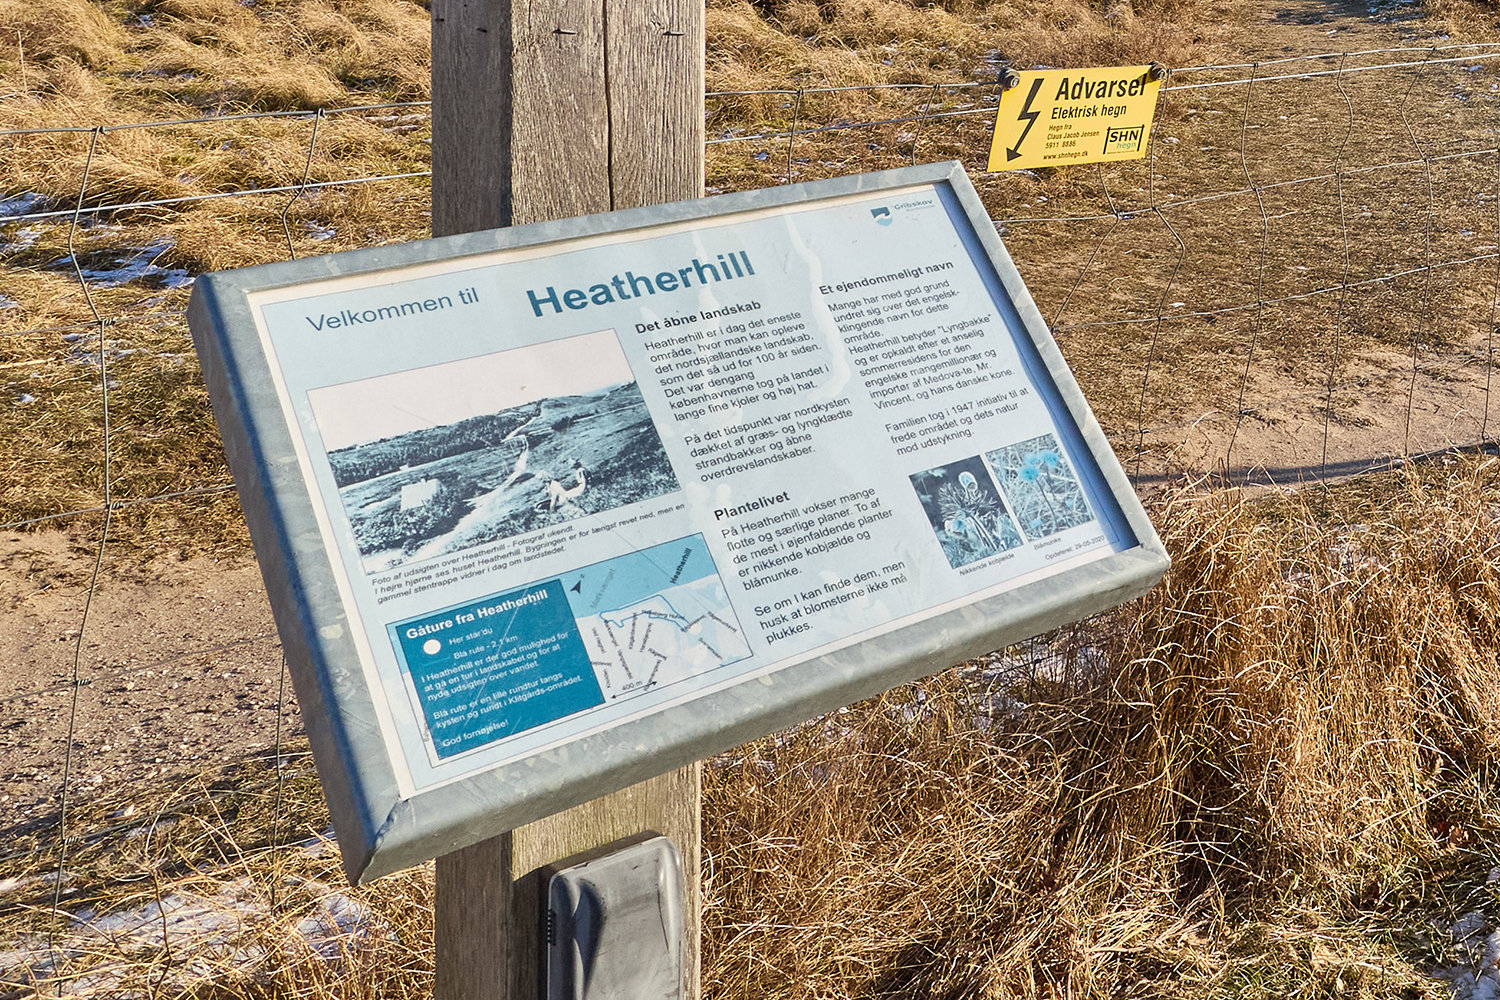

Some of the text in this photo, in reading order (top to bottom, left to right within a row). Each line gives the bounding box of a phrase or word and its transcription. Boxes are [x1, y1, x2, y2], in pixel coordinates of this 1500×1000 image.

[1055, 74, 1148, 101] Advarsel
[1048, 124, 1063, 132] Hegn
[1051, 104, 1127, 120] Elektrisk hegn
[1063, 131, 1080, 139] Jacob
[1080, 130, 1100, 138] Jensen
[1109, 130, 1139, 143] SHN
[526, 250, 755, 317] Heatherhill
[819, 262, 954, 295] Et ejendommeligt navn
[827, 280, 950, 312] Mange har med god grund
[306, 287, 479, 331] Velkommen til
[635, 300, 761, 334] Det åbne landskab
[833, 289, 960, 323] undret sig over det engelsk-
[838, 303, 949, 333] klingende navn for dette
[650, 323, 805, 363] område, hvor man kan opleve
[655, 333, 814, 375] det nordsjællandske landskab,
[844, 330, 885, 344] område.
[848, 336, 901, 355] Heatherhill
[901, 329, 936, 343] betyder
[854, 329, 985, 367] og er opkaldt efter et anselig
[660, 344, 822, 386] som det så ud for 100 år siden.
[859, 344, 972, 377] sommerresidens for den
[865, 349, 997, 388] engelske mangemillionær og
[664, 371, 755, 398] Det var dengang
[869, 362, 992, 399] importør af Medova-te, Mr.
[874, 369, 1017, 410] Vincent, og hans danske kone.
[674, 380, 818, 421] lange fine kjoler og høj hat.
[684, 398, 850, 446] På det tidspunkt var nordkysten
[690, 410, 853, 458] dækket af græs- og lyngklædte
[890, 402, 1018, 444] frede området og dets natur
[695, 433, 812, 470] strandbakker og åbne
[896, 428, 975, 455] mod udstykning.
[701, 446, 816, 482] overdrevslandskaber.
[714, 491, 790, 521] Plantelivet
[721, 488, 876, 539] På Heatherhill vokser mange
[727, 497, 881, 551] flotte og særlige planer. To af
[669, 547, 692, 585] Heatherhill
[738, 530, 871, 578] er nikkende kobjælde og
[377, 588, 412, 605] gammel
[414, 576, 458, 594] stentrappe
[460, 568, 485, 580] vidner
[492, 562, 508, 571] dag
[509, 558, 522, 566] om
[524, 545, 568, 562] landstedet.
[742, 567, 803, 591] blåmunke.
[754, 606, 772, 617] Se
[774, 598, 793, 610] om
[800, 588, 823, 601] kan
[824, 579, 852, 593] finde
[853, 570, 881, 583] dem,
[882, 561, 905, 574] men
[406, 589, 548, 639] Gåture fra Heatherhill
[759, 573, 907, 630] husk at blomsterne ikke må
[766, 622, 814, 645] plukkes.
